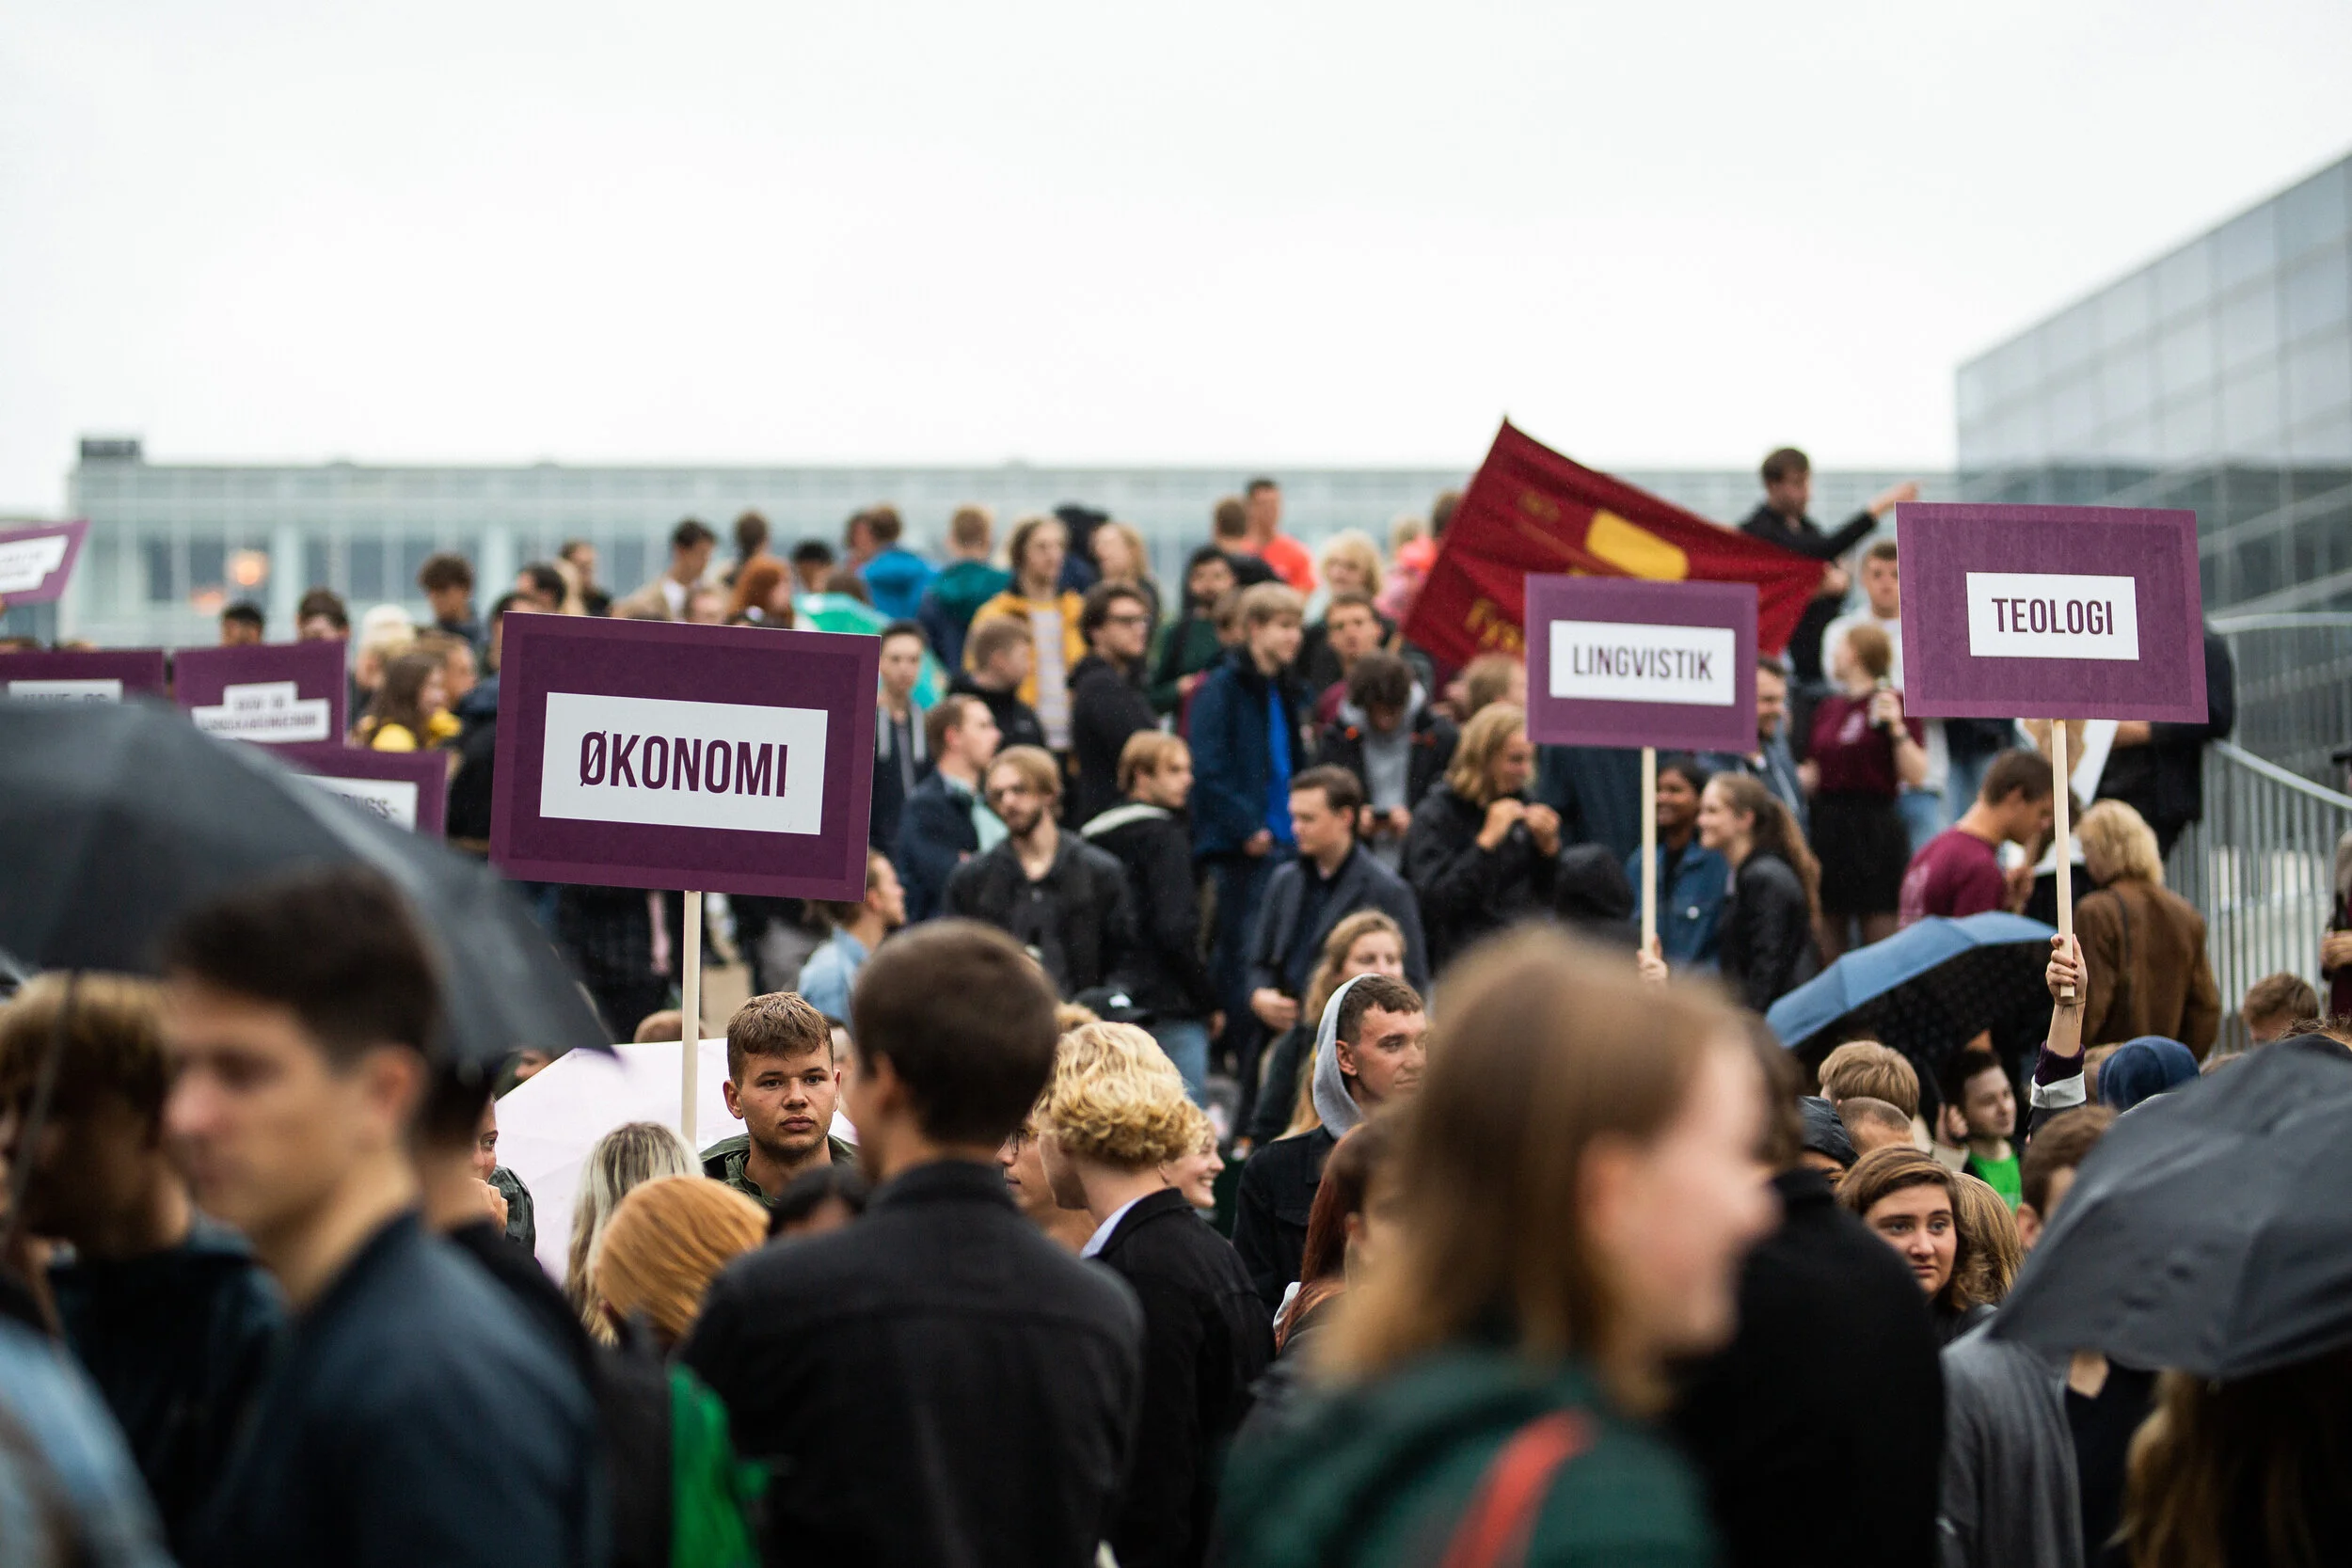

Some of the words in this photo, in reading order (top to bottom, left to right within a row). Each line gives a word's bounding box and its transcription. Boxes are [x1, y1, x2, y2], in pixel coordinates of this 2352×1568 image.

[1991, 597, 2114, 636] TEOLOGI
[1572, 643, 1713, 682] LINGVISTIK
[580, 730, 788, 798] ØKONOMI
